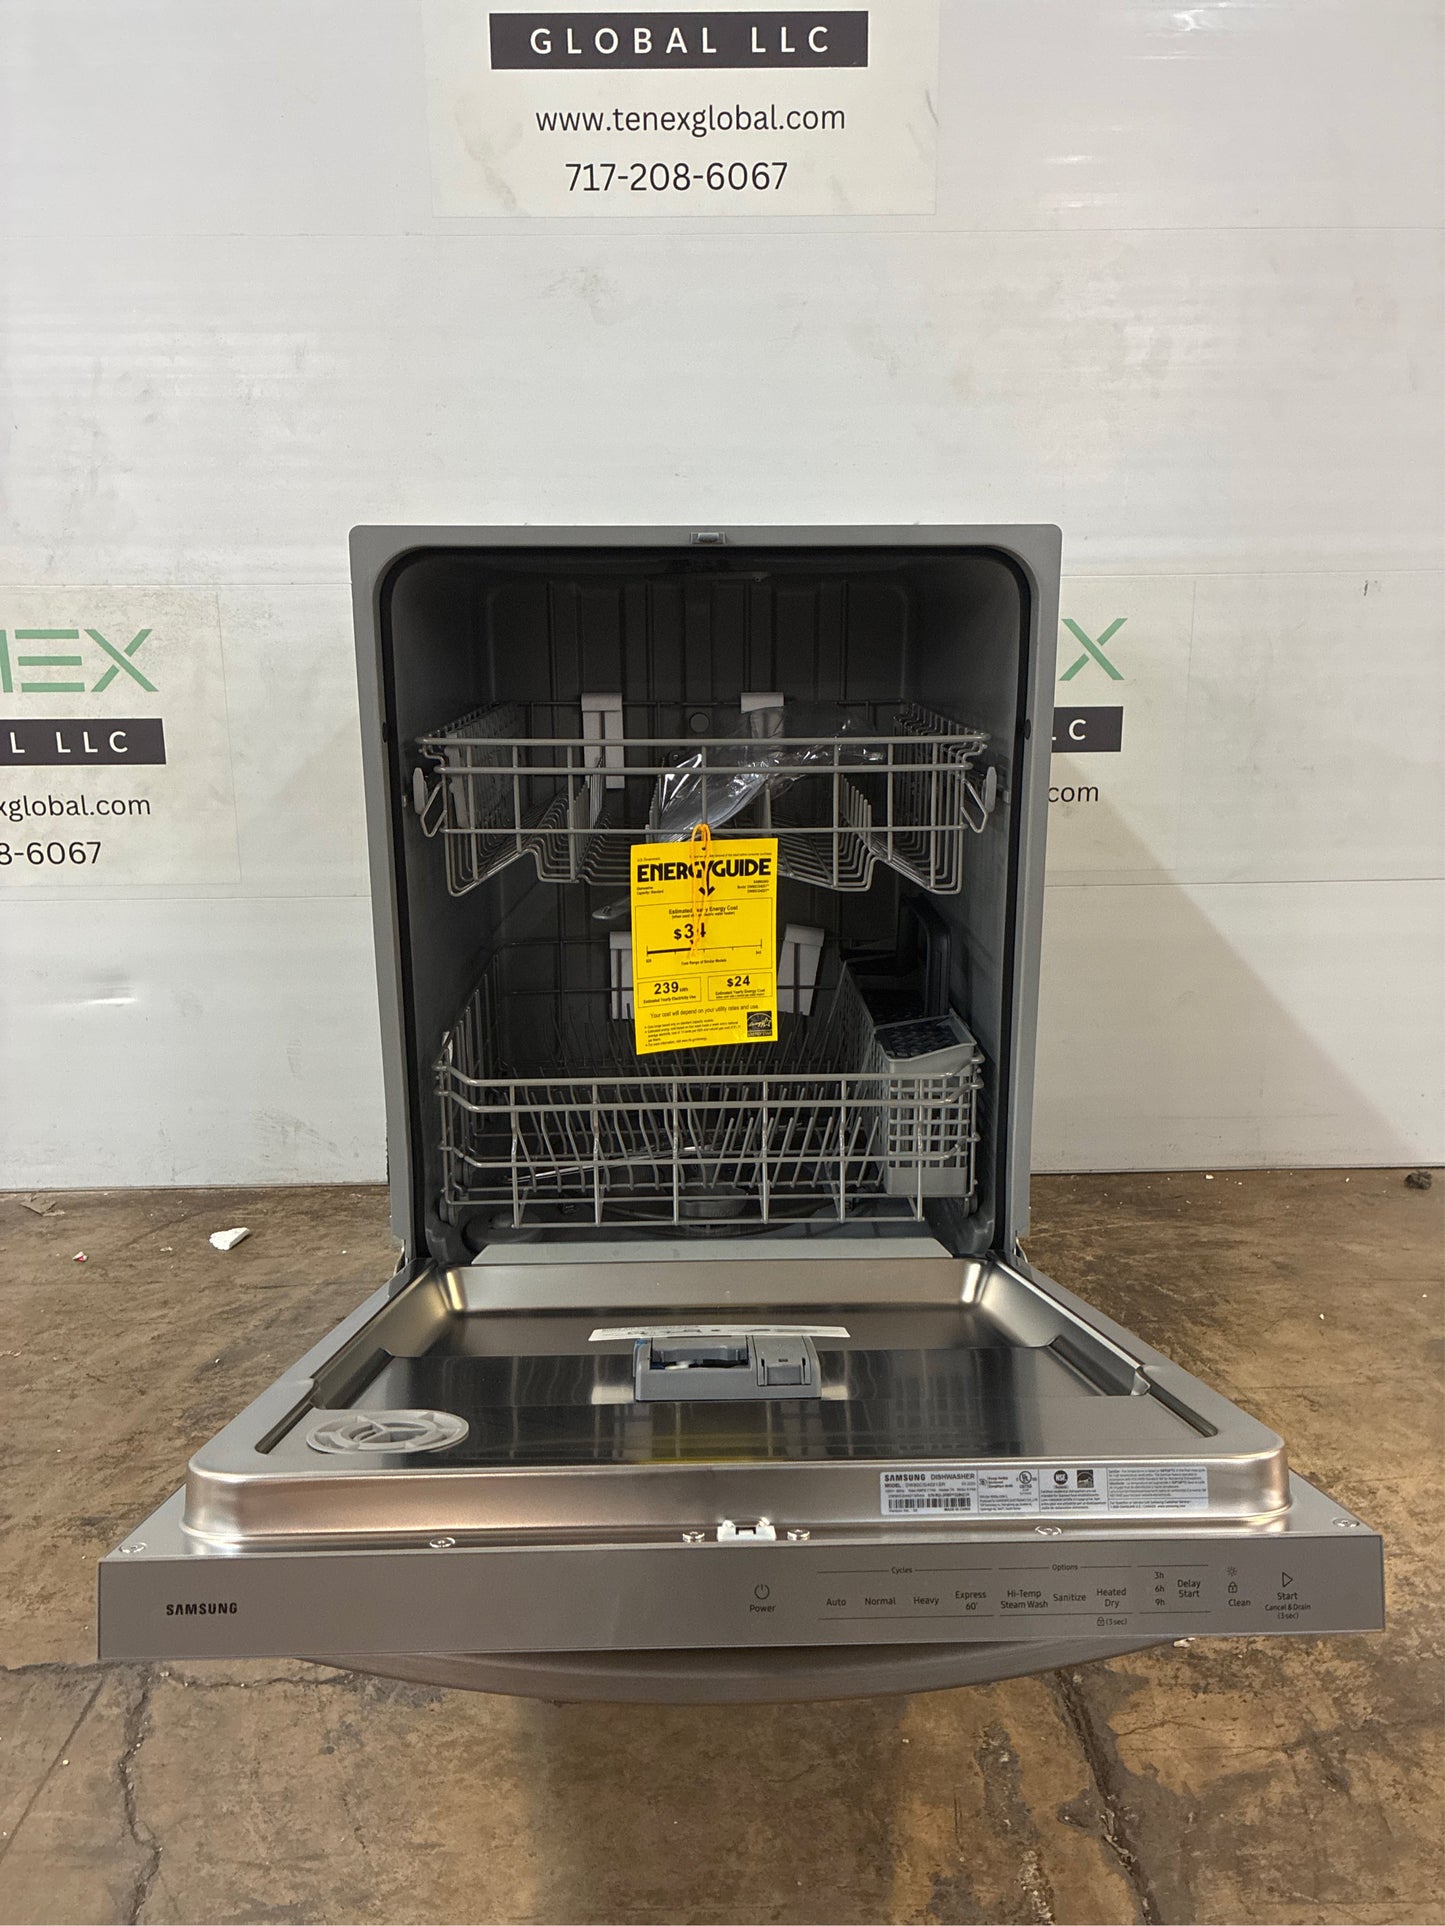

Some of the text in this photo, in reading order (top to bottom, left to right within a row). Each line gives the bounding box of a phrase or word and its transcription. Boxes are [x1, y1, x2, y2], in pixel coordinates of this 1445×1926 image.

[530, 26, 830, 55] GLOBAL LLC
[535, 104, 845, 137] www.tenexglobal.com
[565, 162, 788, 192] 717-208-6067
[56, 731, 129, 753] LLC
[637, 857, 771, 886] ENERGYGUIDE
[727, 975, 750, 988] $24
[654, 981, 679, 995] 239
[680, 1009, 696, 1017] depend
[884, 1473, 975, 1482] SAMSUNG DISHWASHER
[891, 1563, 1078, 1575] Cycles Options
[1154, 1571, 1165, 1579] 3h
[1155, 1584, 1165, 1593] 6h
[1177, 1579, 1201, 1590] Delay
[955, 1590, 987, 1600] Express
[1007, 1589, 1041, 1598] Hi-Temp
[1096, 1587, 1127, 1596] Heated
[1178, 1589, 1200, 1598] Start
[1277, 1591, 1298, 1600] Start
[826, 1596, 940, 1607] Auto Normal Heavy
[1053, 1593, 1087, 1602] Sanitize
[1155, 1598, 1166, 1607] 9h
[1228, 1598, 1251, 1607] Clean
[749, 1603, 776, 1613] Power
[1000, 1599, 1049, 1609] Steam Wash
[1104, 1598, 1120, 1609] Dry
[1264, 1603, 1287, 1611] Cancel
[166, 1602, 238, 1616] SAMSUNG
